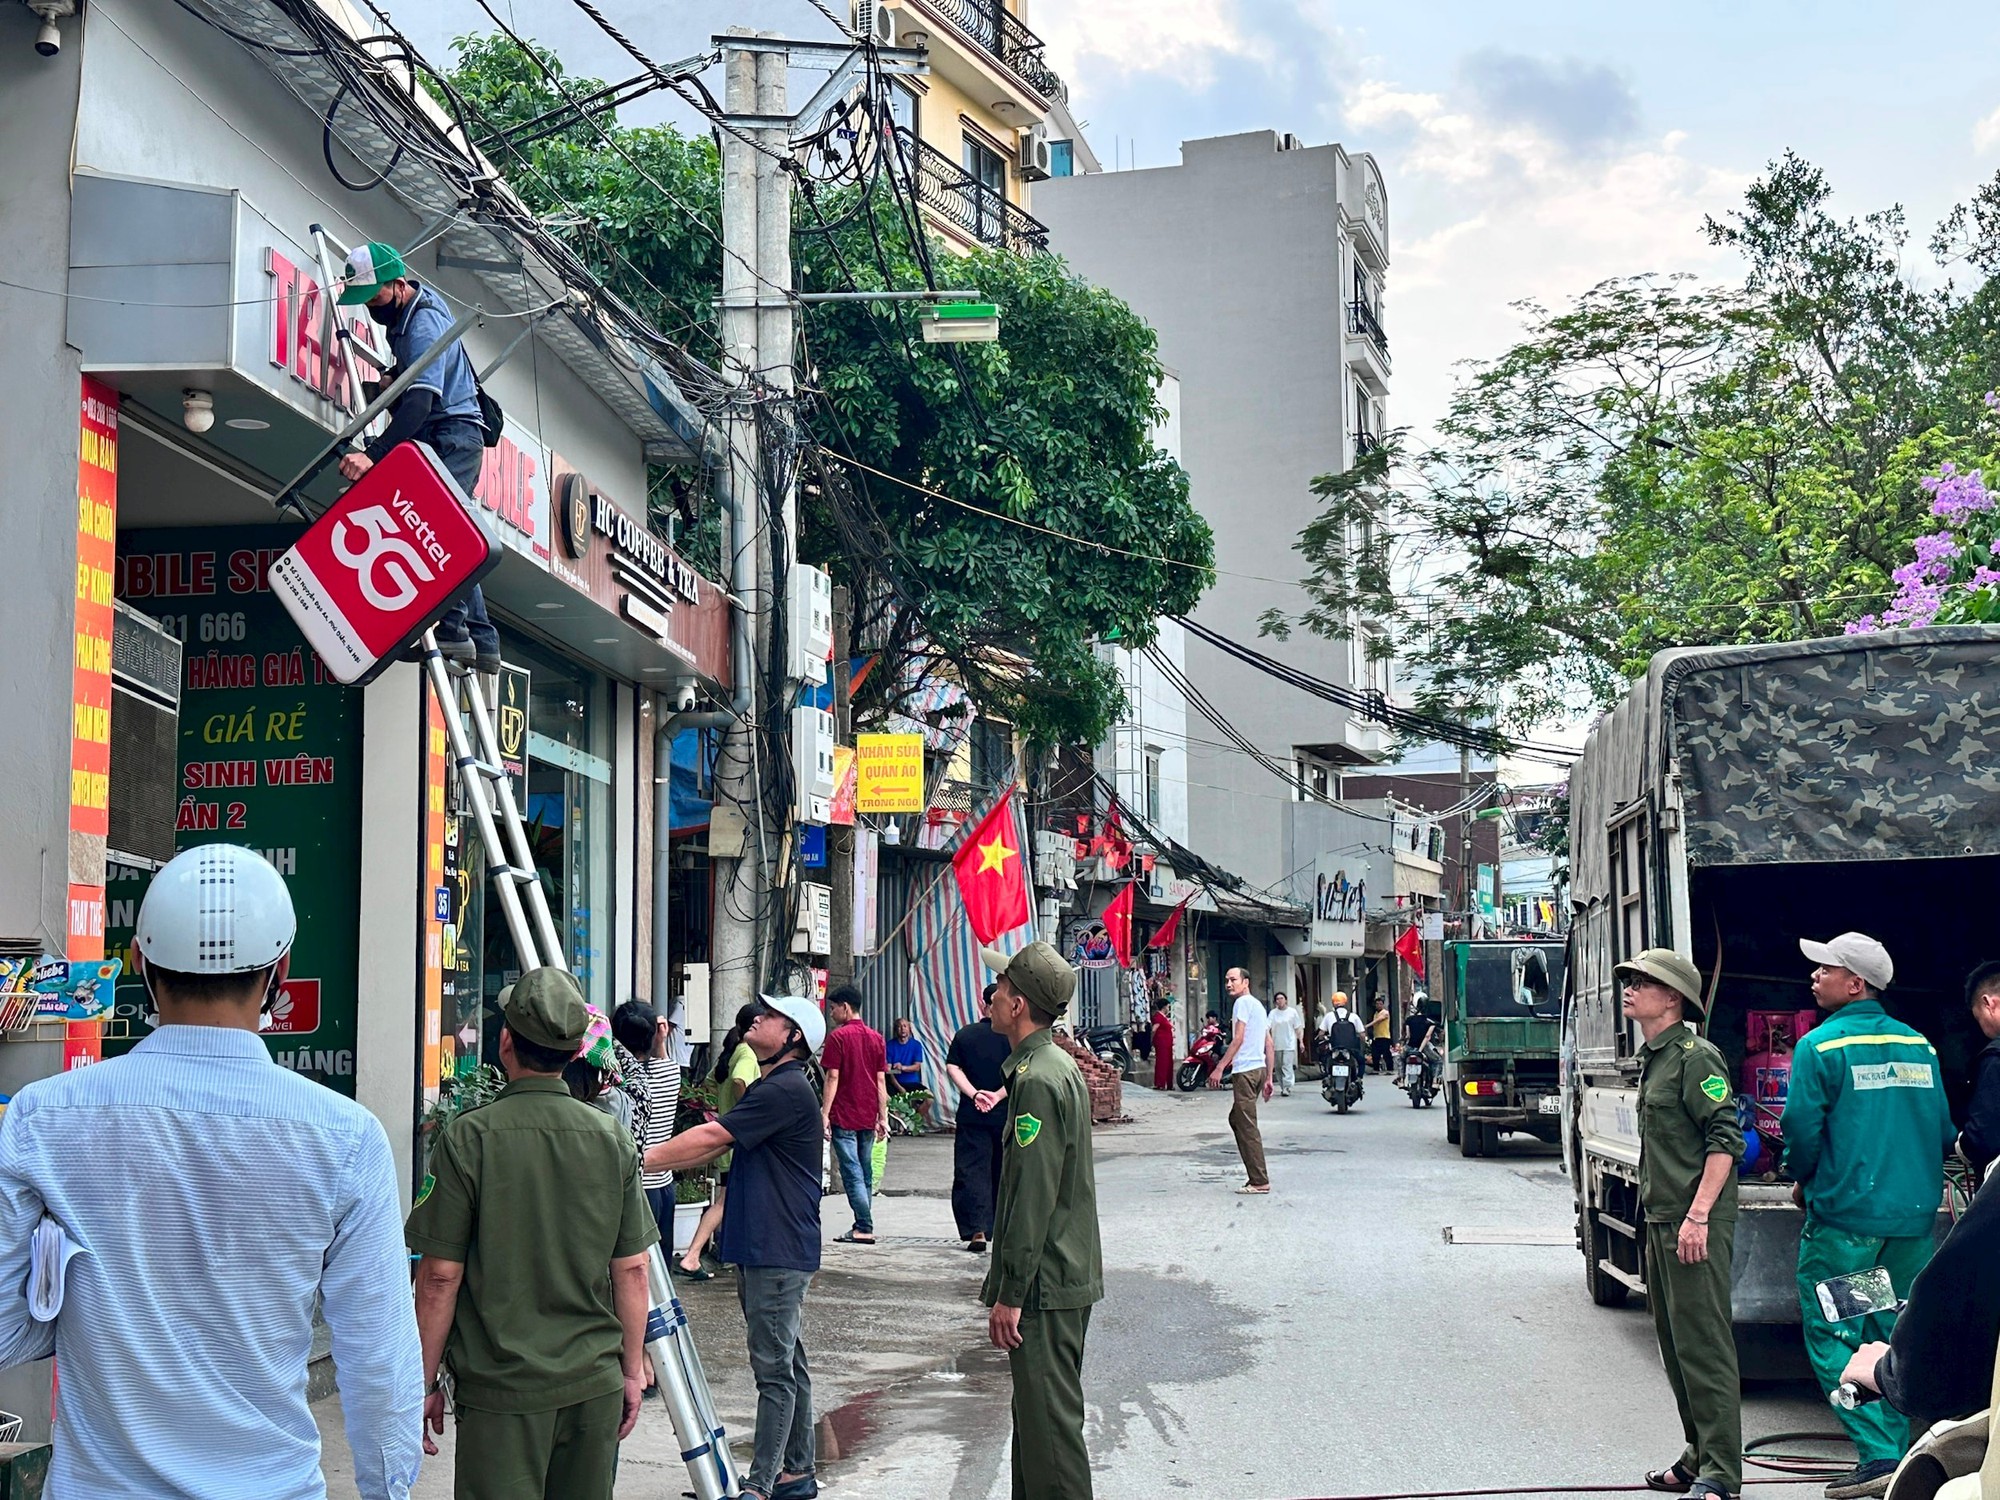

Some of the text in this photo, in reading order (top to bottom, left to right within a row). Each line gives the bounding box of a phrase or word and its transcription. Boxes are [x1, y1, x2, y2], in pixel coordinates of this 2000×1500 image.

[82, 427, 115, 473] MUA BÁN
[391, 489, 452, 571] viettel
[596, 494, 700, 606] HC COFFEE & TEA
[228, 548, 286, 594] SH
[331, 505, 436, 611] 5G
[77, 555, 113, 608] ÉP KÍNH
[200, 612, 246, 642] 666
[188, 649, 256, 690] HÃNG
[263, 645, 305, 687] GIÁ
[203, 706, 256, 743] GIÁ
[265, 702, 307, 742] RẺ
[184, 753, 335, 789] SINH VIÊN
[902, 762, 917, 777] ÁO
[226, 802, 246, 829] 2
[861, 799, 895, 807] TRONG
[71, 890, 103, 937] THAY THẾ
[437, 893, 448, 915] 35
[277, 1046, 352, 1075] HÃNG
